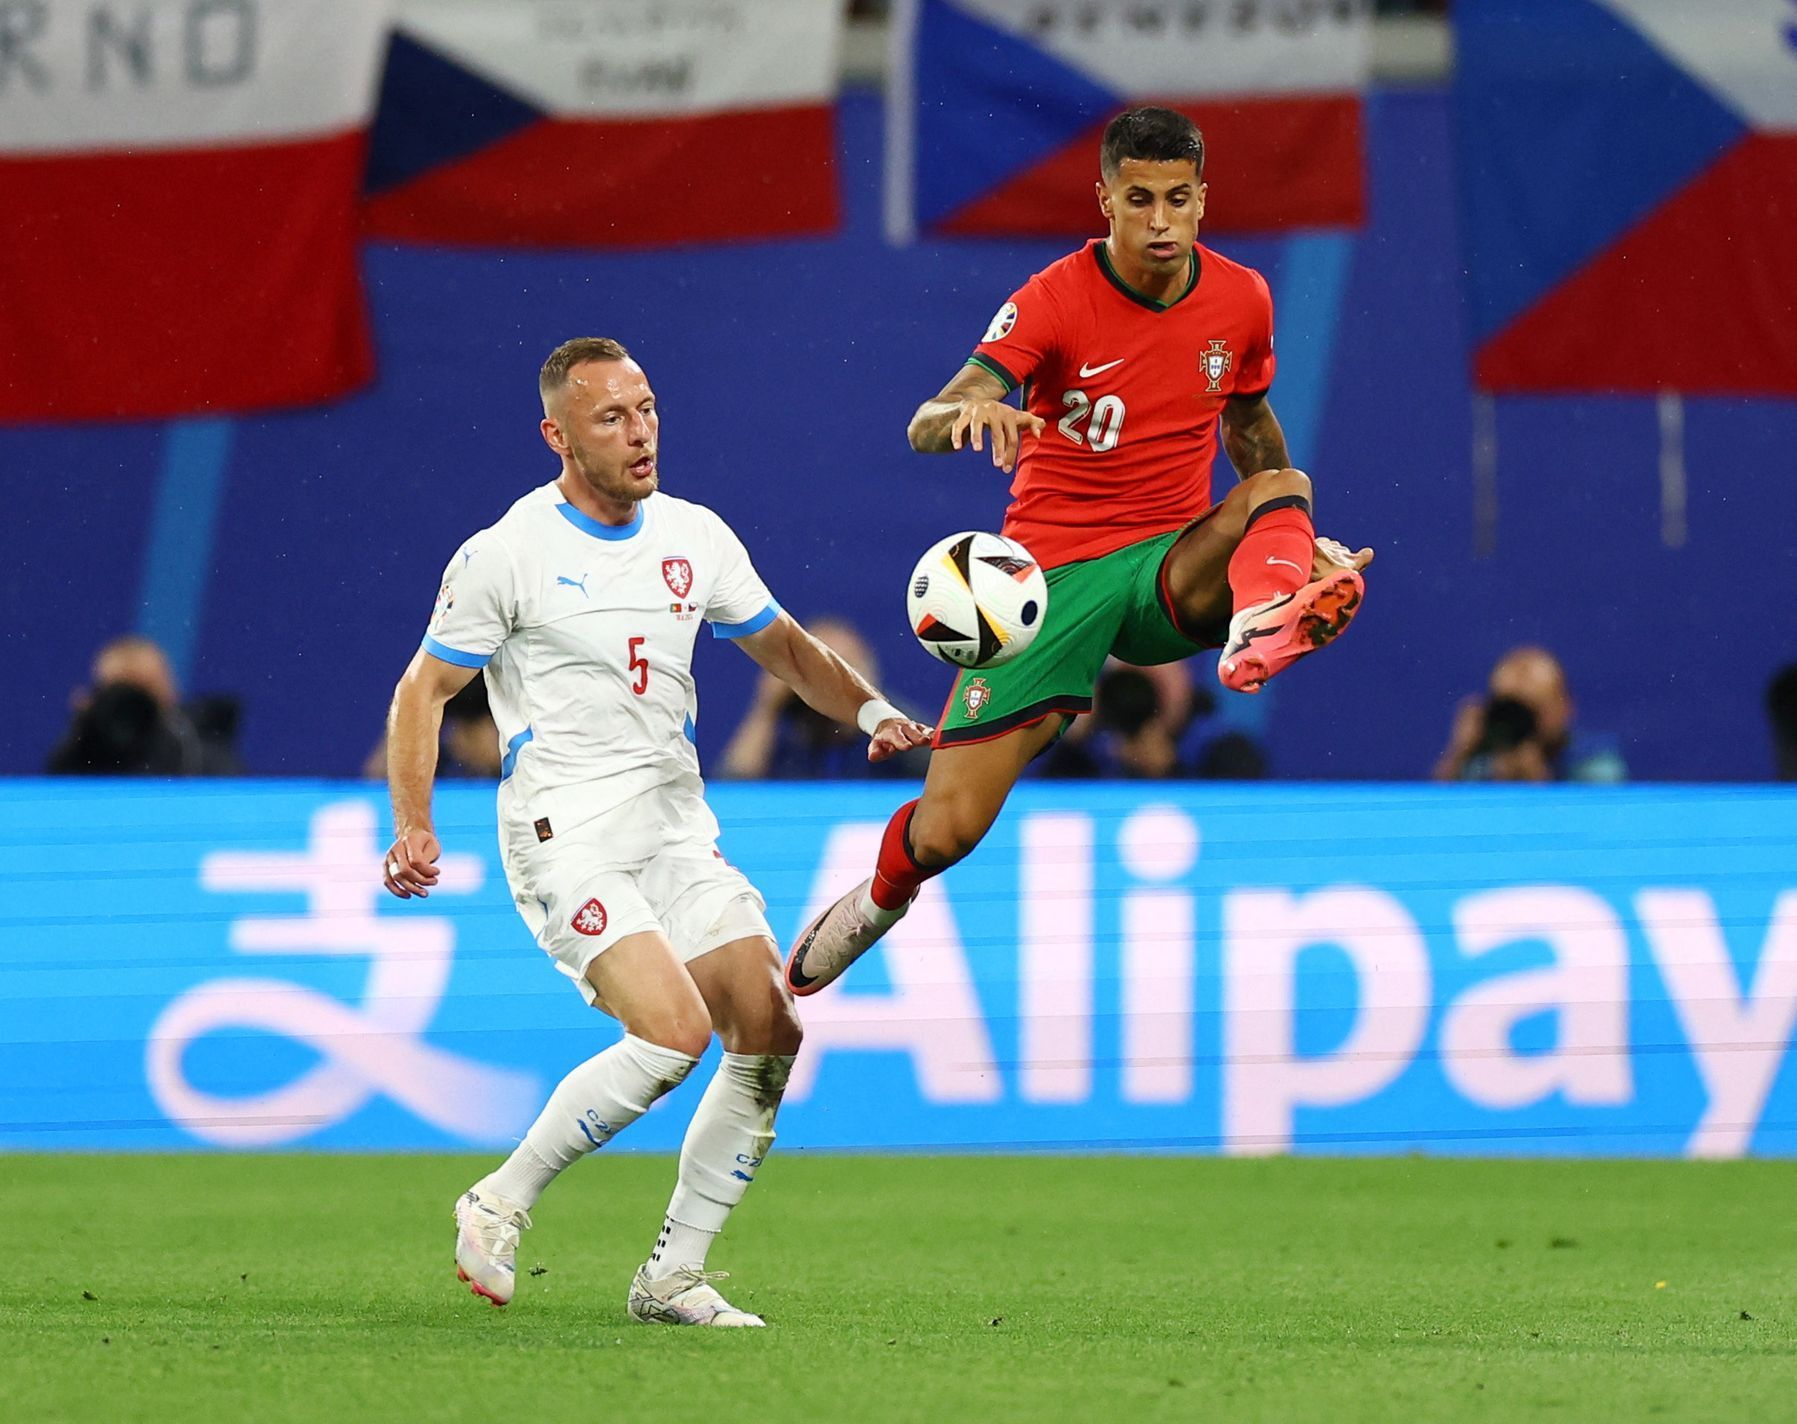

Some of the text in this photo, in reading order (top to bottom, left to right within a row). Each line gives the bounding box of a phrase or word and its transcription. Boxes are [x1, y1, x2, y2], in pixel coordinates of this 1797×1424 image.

[1057, 388, 1126, 452] 20
[627, 636, 649, 695] 5
[784, 803, 1797, 1160] Alipay
